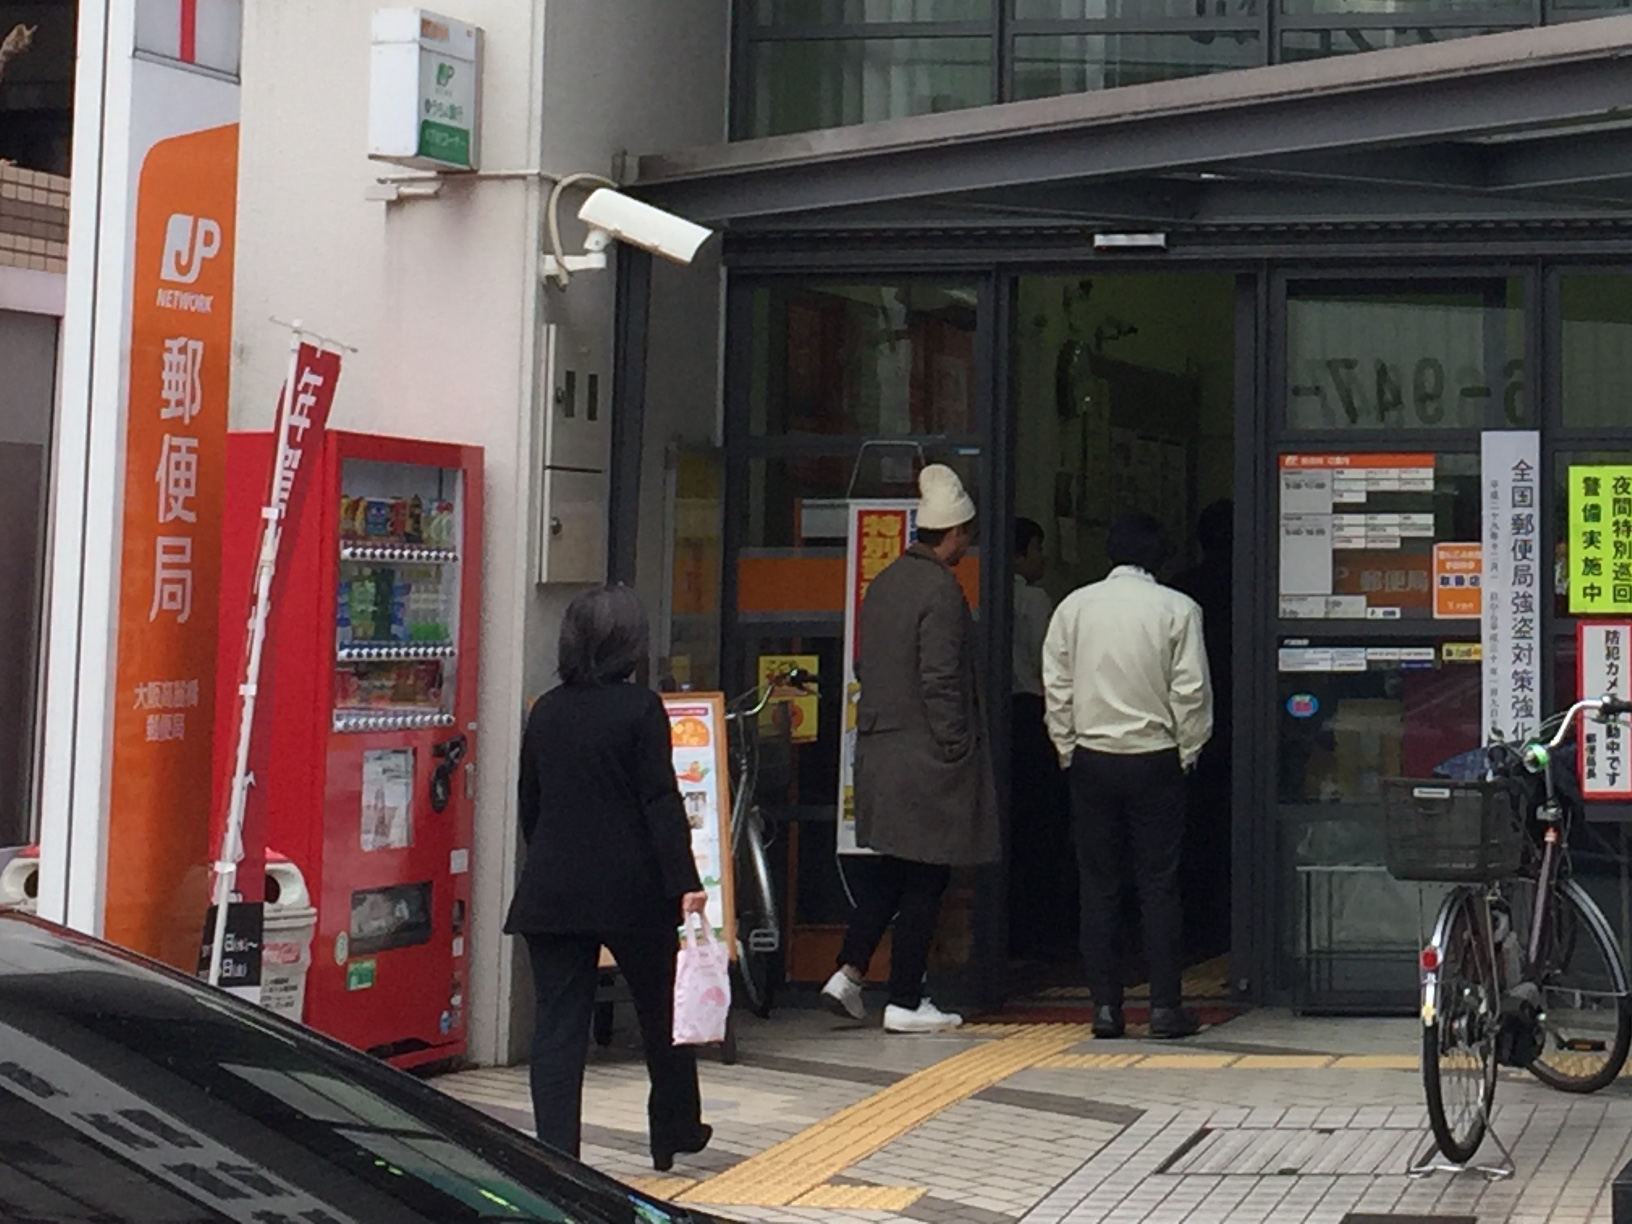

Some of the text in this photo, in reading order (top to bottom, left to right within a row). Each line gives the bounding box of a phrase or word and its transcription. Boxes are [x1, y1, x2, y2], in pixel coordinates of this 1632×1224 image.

[155, 288, 214, 314] NETWORK
[149, 336, 205, 624] 郵便局
[1581, 476, 1603, 604] 警備実施中
